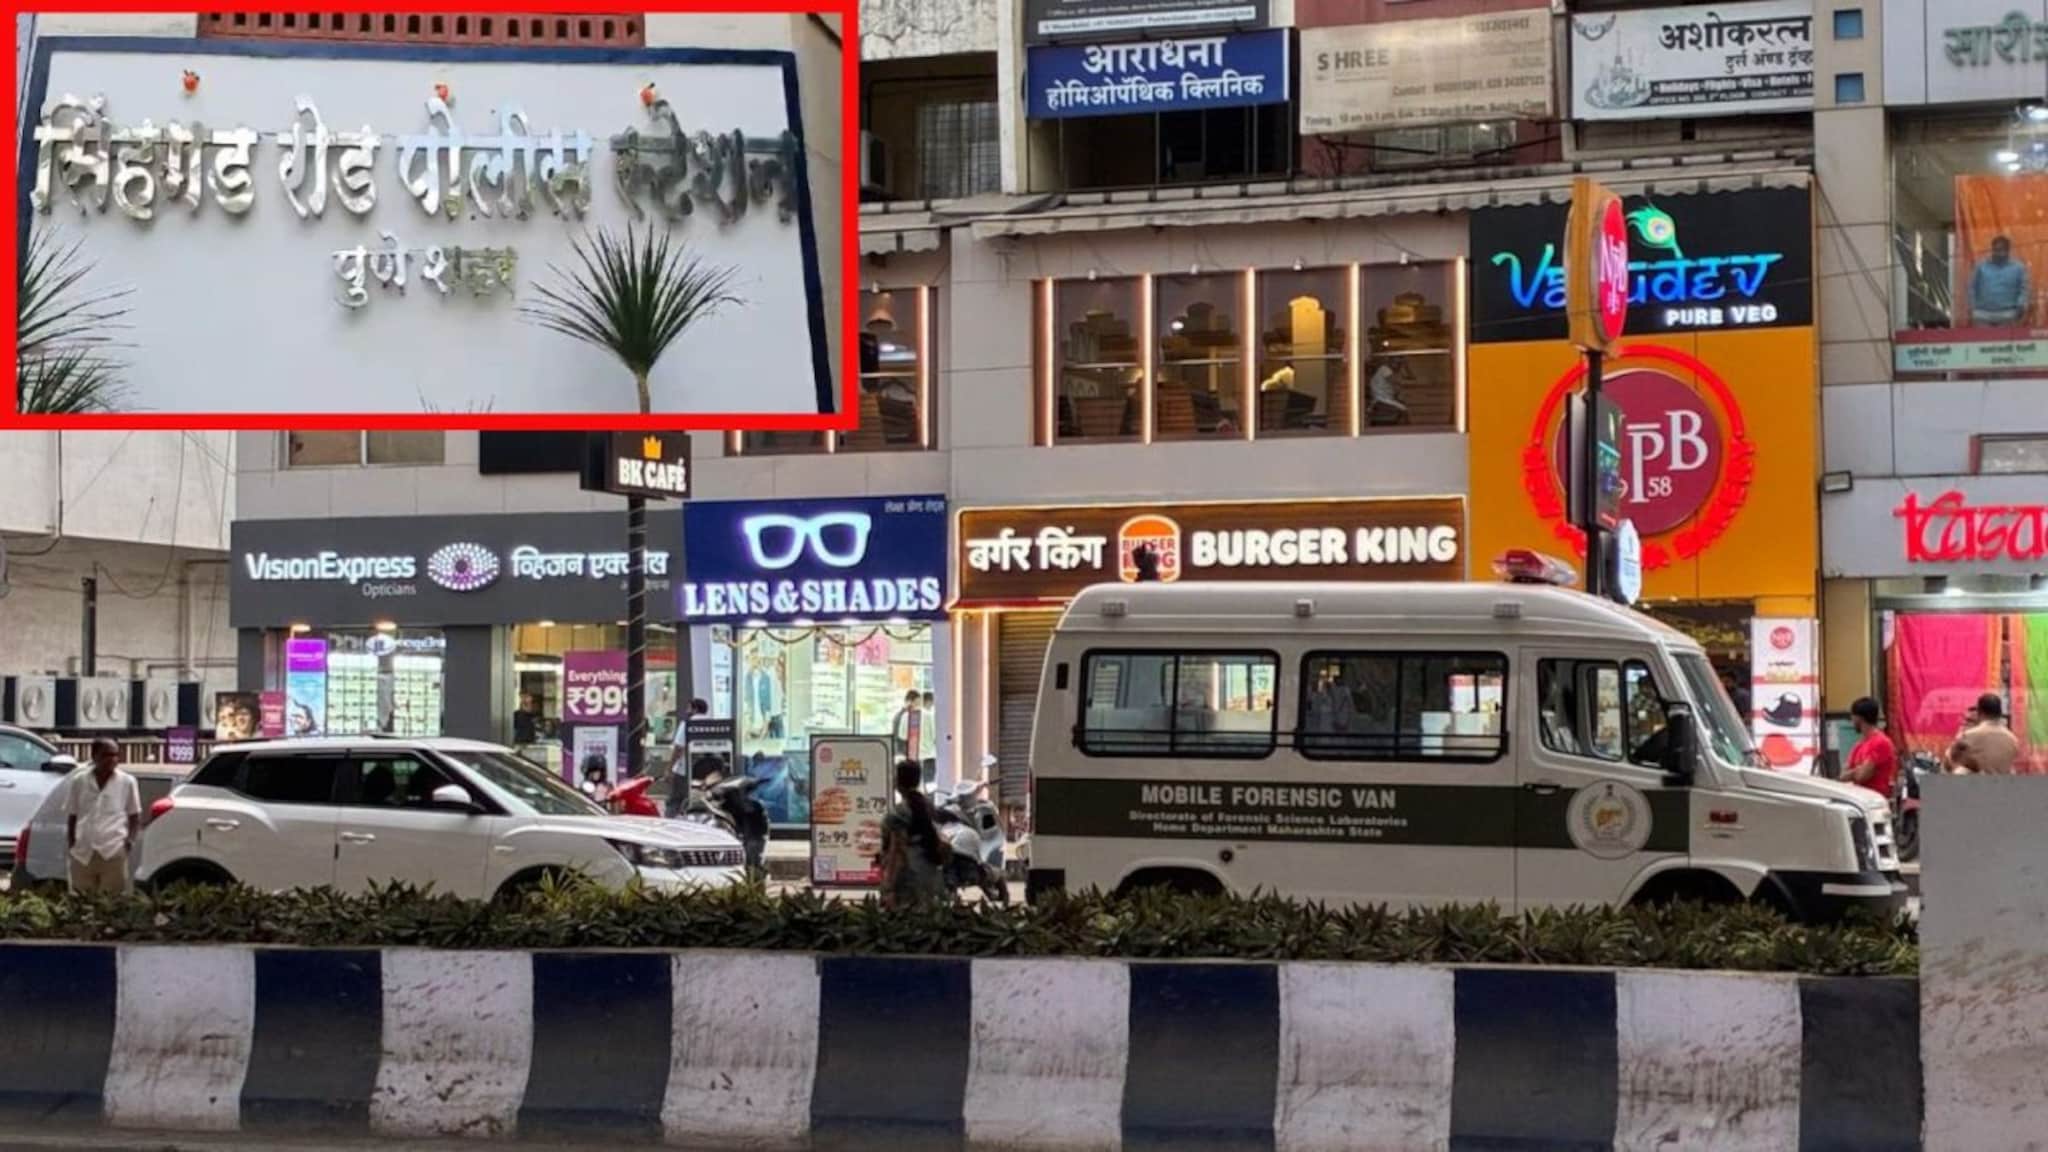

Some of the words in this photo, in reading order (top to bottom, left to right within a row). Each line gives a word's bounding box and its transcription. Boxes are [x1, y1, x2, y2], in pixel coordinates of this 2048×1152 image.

[1659, 11, 1812, 50] अशोकरत्न
[1082, 36, 1227, 74] आराधना
[1181, 69, 1264, 99] क्लिनिक
[277, 94, 382, 219] रोड
[398, 92, 593, 221] पोलीस
[333, 232, 409, 309] पुणे
[423, 245, 518, 299] शहर
[1666, 308, 1724, 326] PURE
[1730, 304, 1777, 322] VEG
[619, 458, 643, 487] BK
[646, 457, 686, 492] CAFÉ
[966, 527, 1030, 571] बर्गर
[1037, 525, 1107, 569] किंग
[1191, 528, 1350, 568] BURGER
[1356, 524, 1459, 565] KING
[361, 582, 416, 598] Opticians
[567, 669, 628, 684] Everything
[1141, 785, 1223, 804] MOBILE
[1232, 787, 1343, 807] FORENSIC
[1351, 789, 1397, 808] VAN
[1129, 810, 1197, 821] Directorate
[1201, 811, 1214, 821] of
[1217, 812, 1271, 823] Forensic
[1276, 813, 1325, 824] Science
[1329, 815, 1408, 827] Laboratories
[1153, 822, 1187, 832] Home
[1192, 822, 1263, 835] Department
[1267, 824, 1344, 836] Maharashtra
[1349, 826, 1383, 837] State
